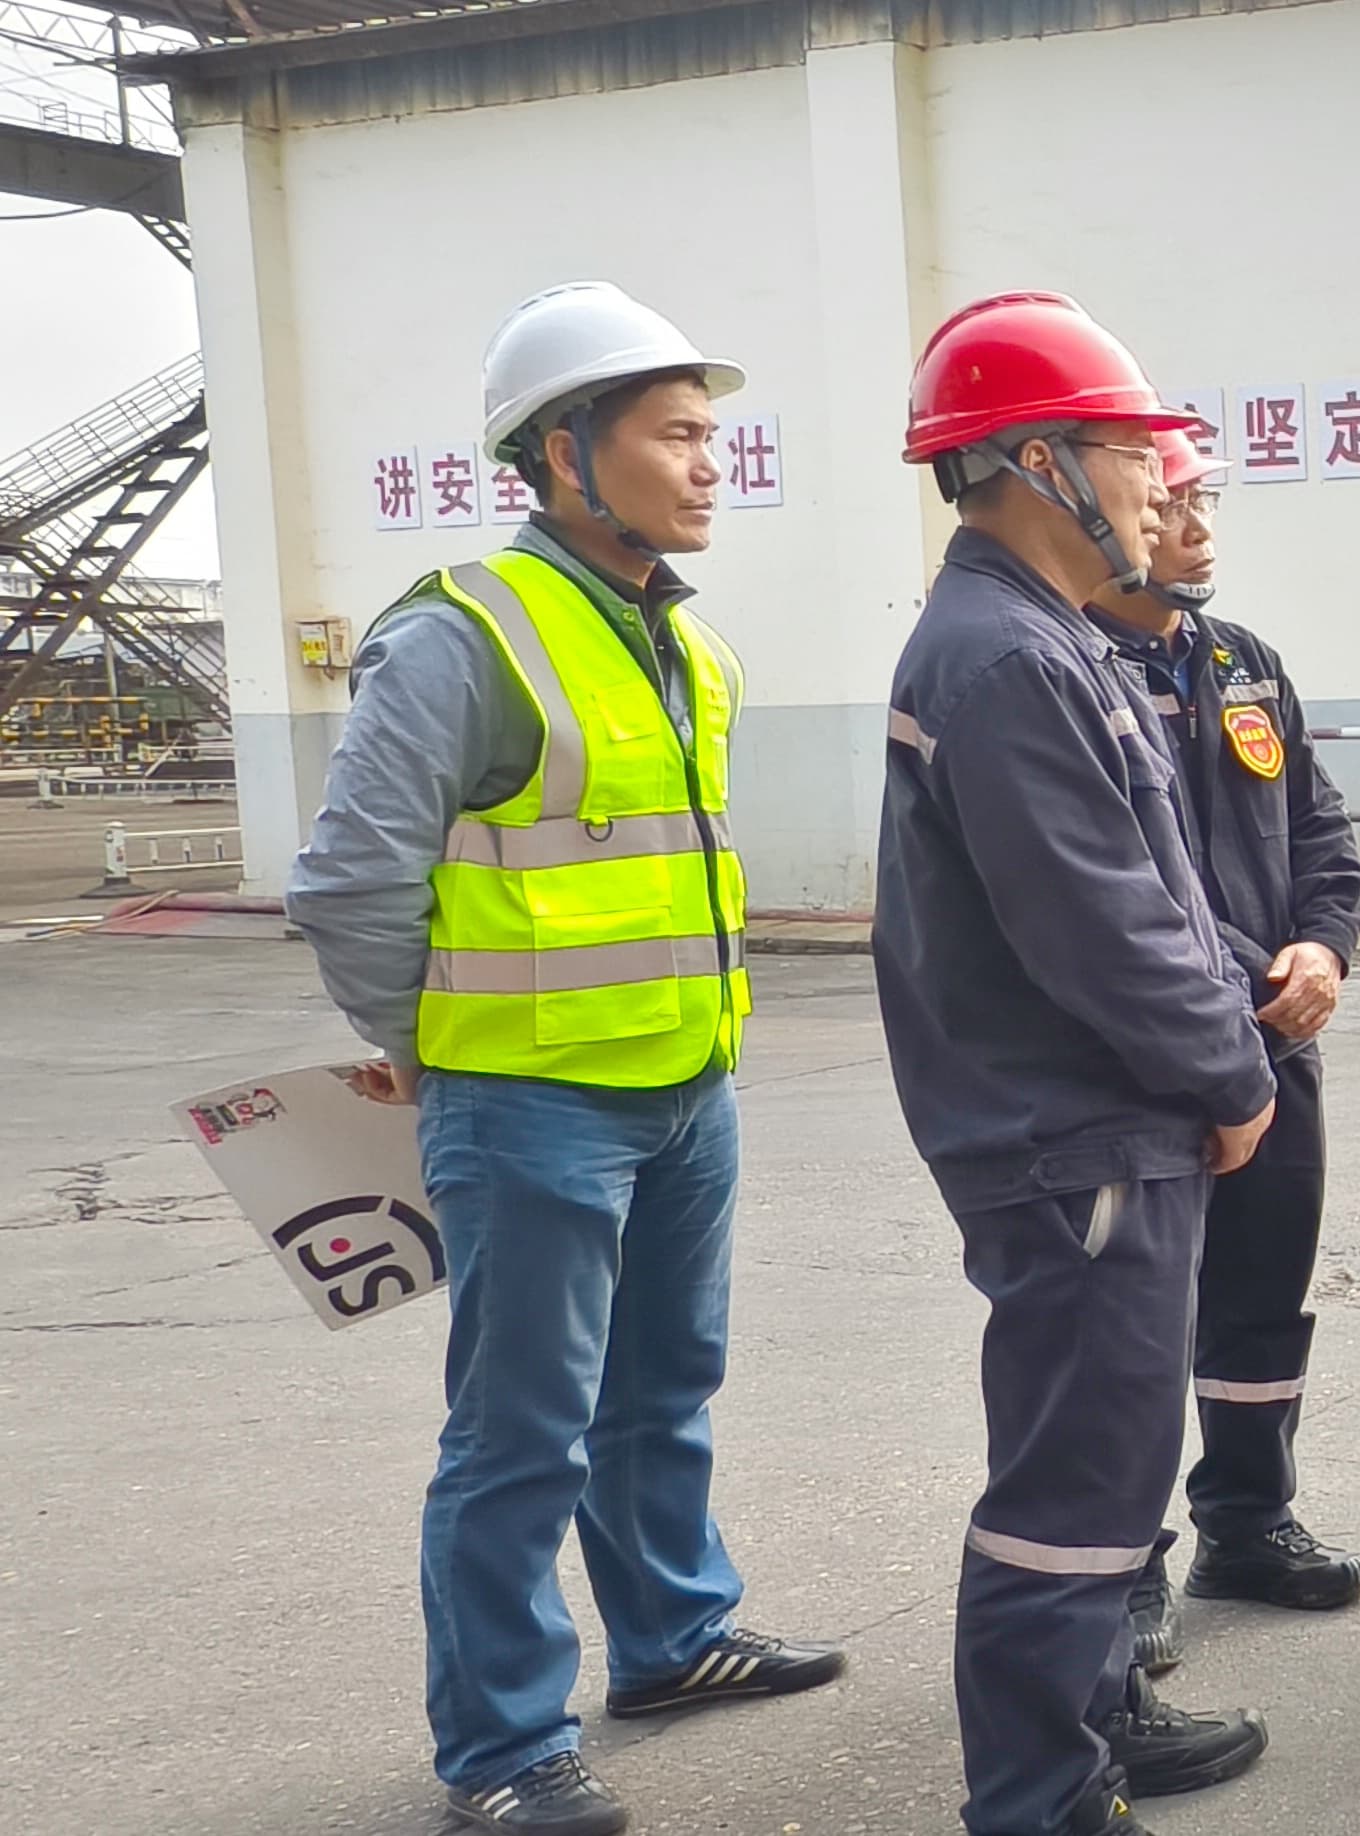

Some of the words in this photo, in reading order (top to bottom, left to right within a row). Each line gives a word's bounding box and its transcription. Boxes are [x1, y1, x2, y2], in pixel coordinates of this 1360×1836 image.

[374, 452, 531, 519] 讲安全
[728, 424, 776, 495] 壮
